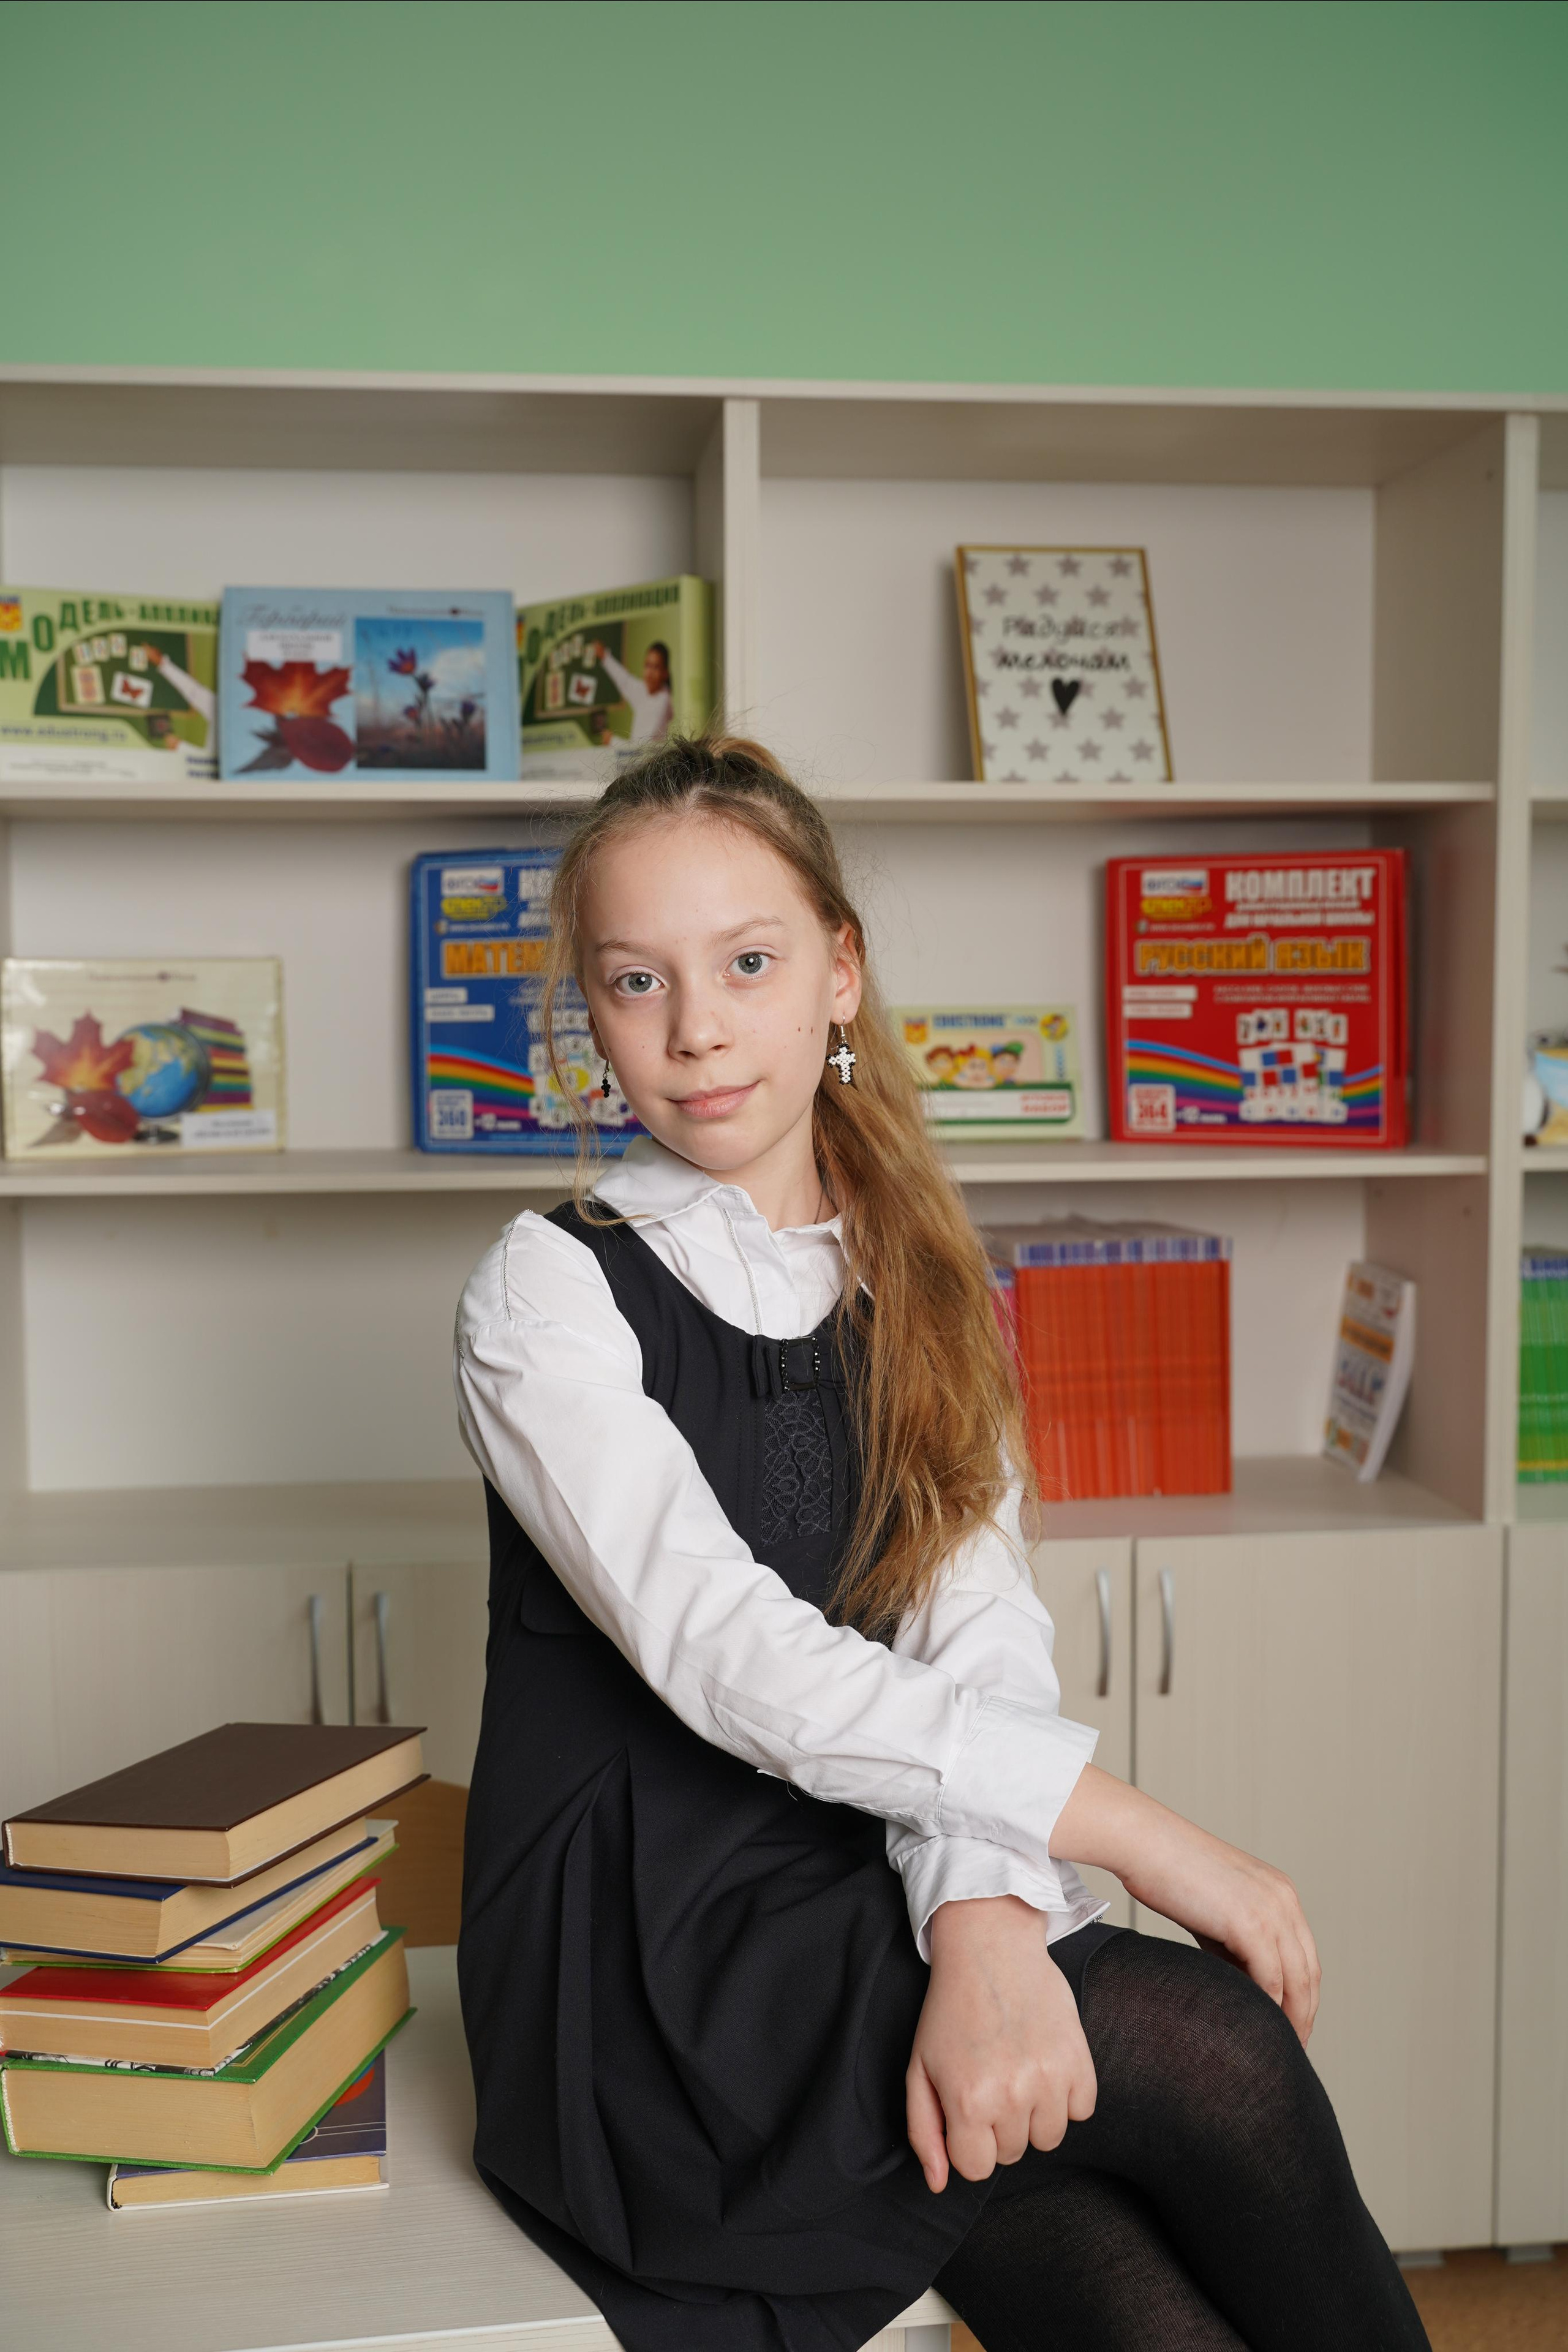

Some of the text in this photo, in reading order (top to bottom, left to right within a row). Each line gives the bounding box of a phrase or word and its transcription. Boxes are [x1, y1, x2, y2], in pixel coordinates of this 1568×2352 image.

[1226, 867, 1376, 902] КОМПЛЕКТ
[1137, 935, 1369, 973] РУССКИЙ ЯЗЫК
